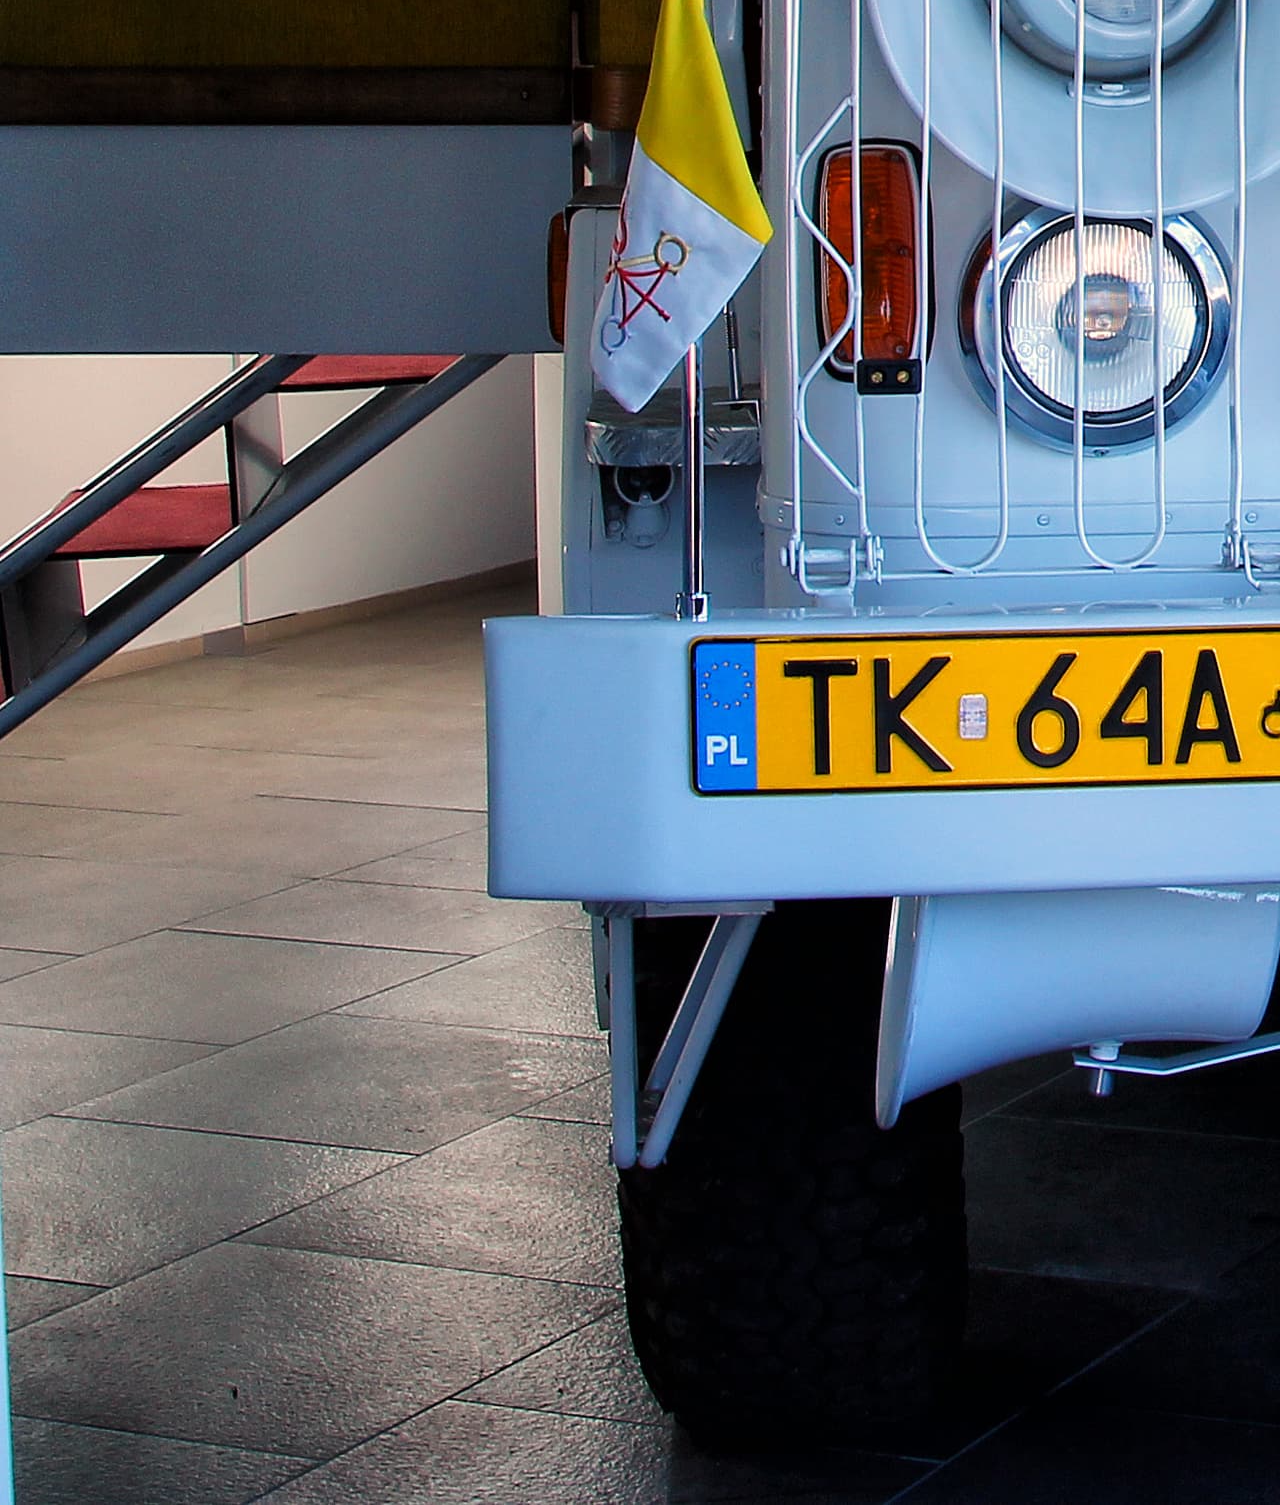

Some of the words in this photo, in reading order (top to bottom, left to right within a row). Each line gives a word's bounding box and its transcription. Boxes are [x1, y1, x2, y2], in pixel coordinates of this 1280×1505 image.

[705, 734, 748, 766] PL
[783, 655, 954, 775] TK
[1016, 649, 1242, 768] 64A
